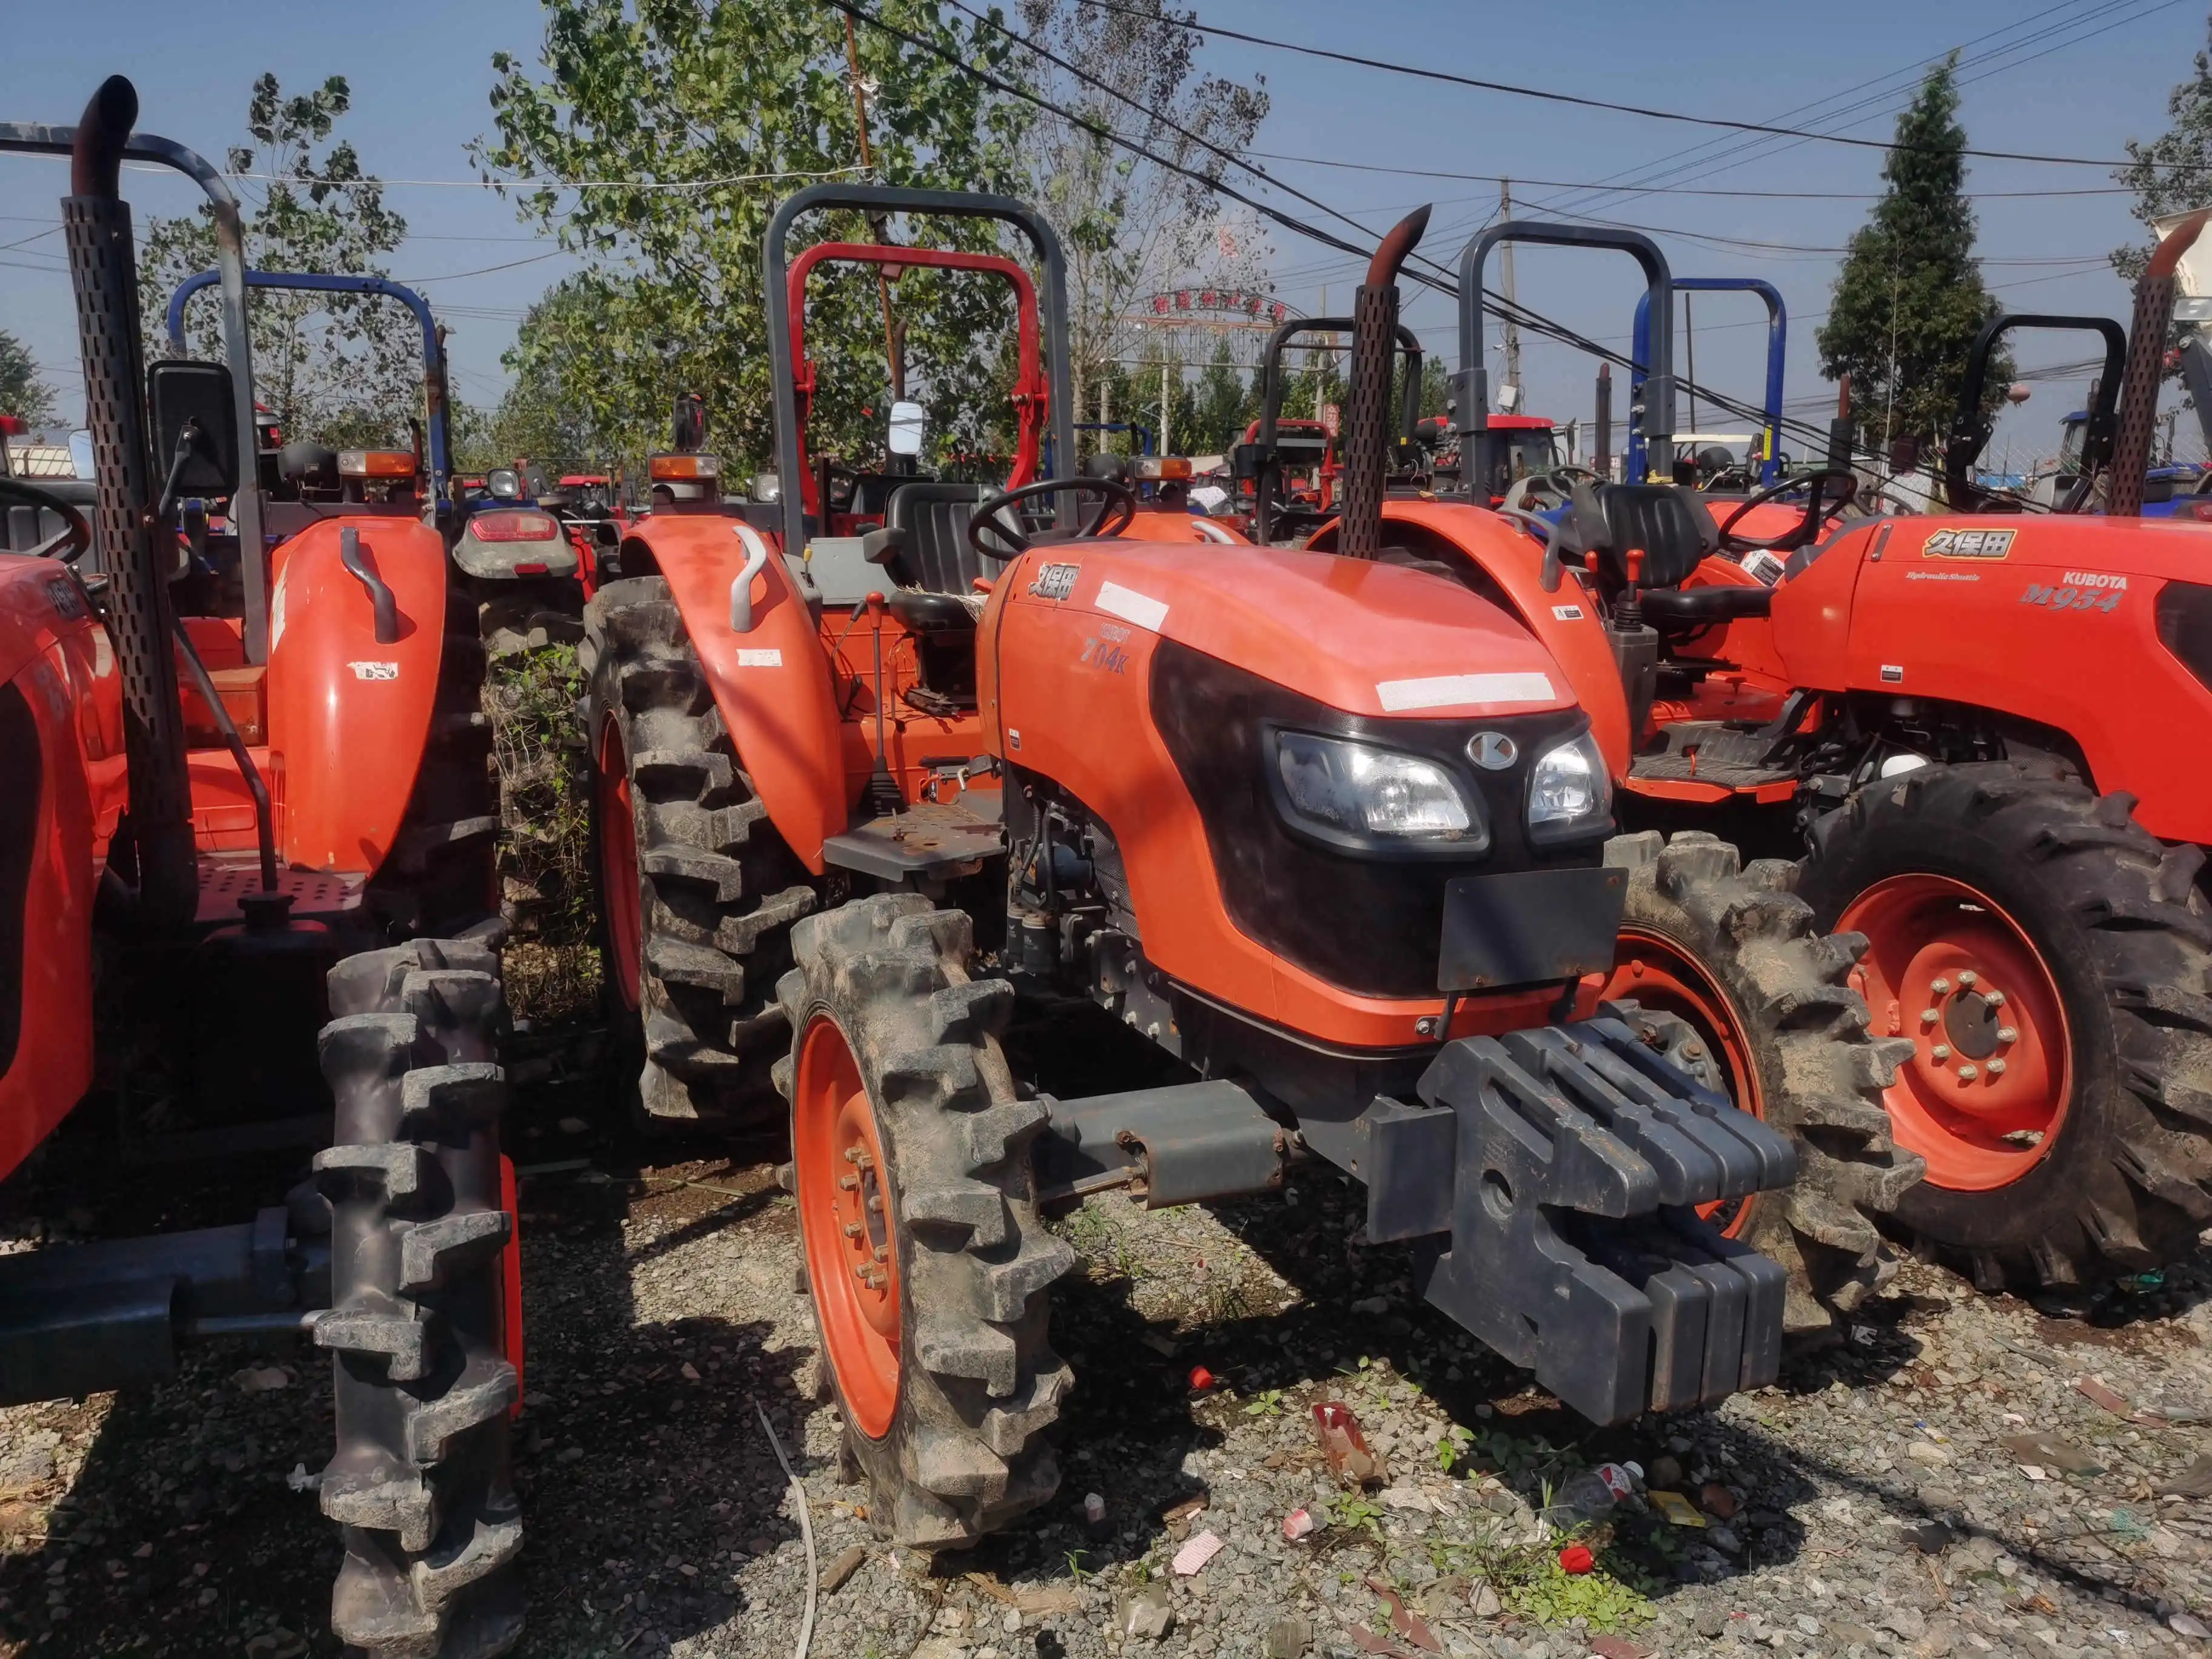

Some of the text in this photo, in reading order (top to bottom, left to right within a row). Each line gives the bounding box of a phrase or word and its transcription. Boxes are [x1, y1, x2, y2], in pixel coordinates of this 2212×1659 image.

[1923, 529, 2016, 558] 久保田
[1028, 563, 1079, 601] 久保田
[2063, 572, 2127, 590] KUBOTA
[2019, 585, 2123, 613] M954
